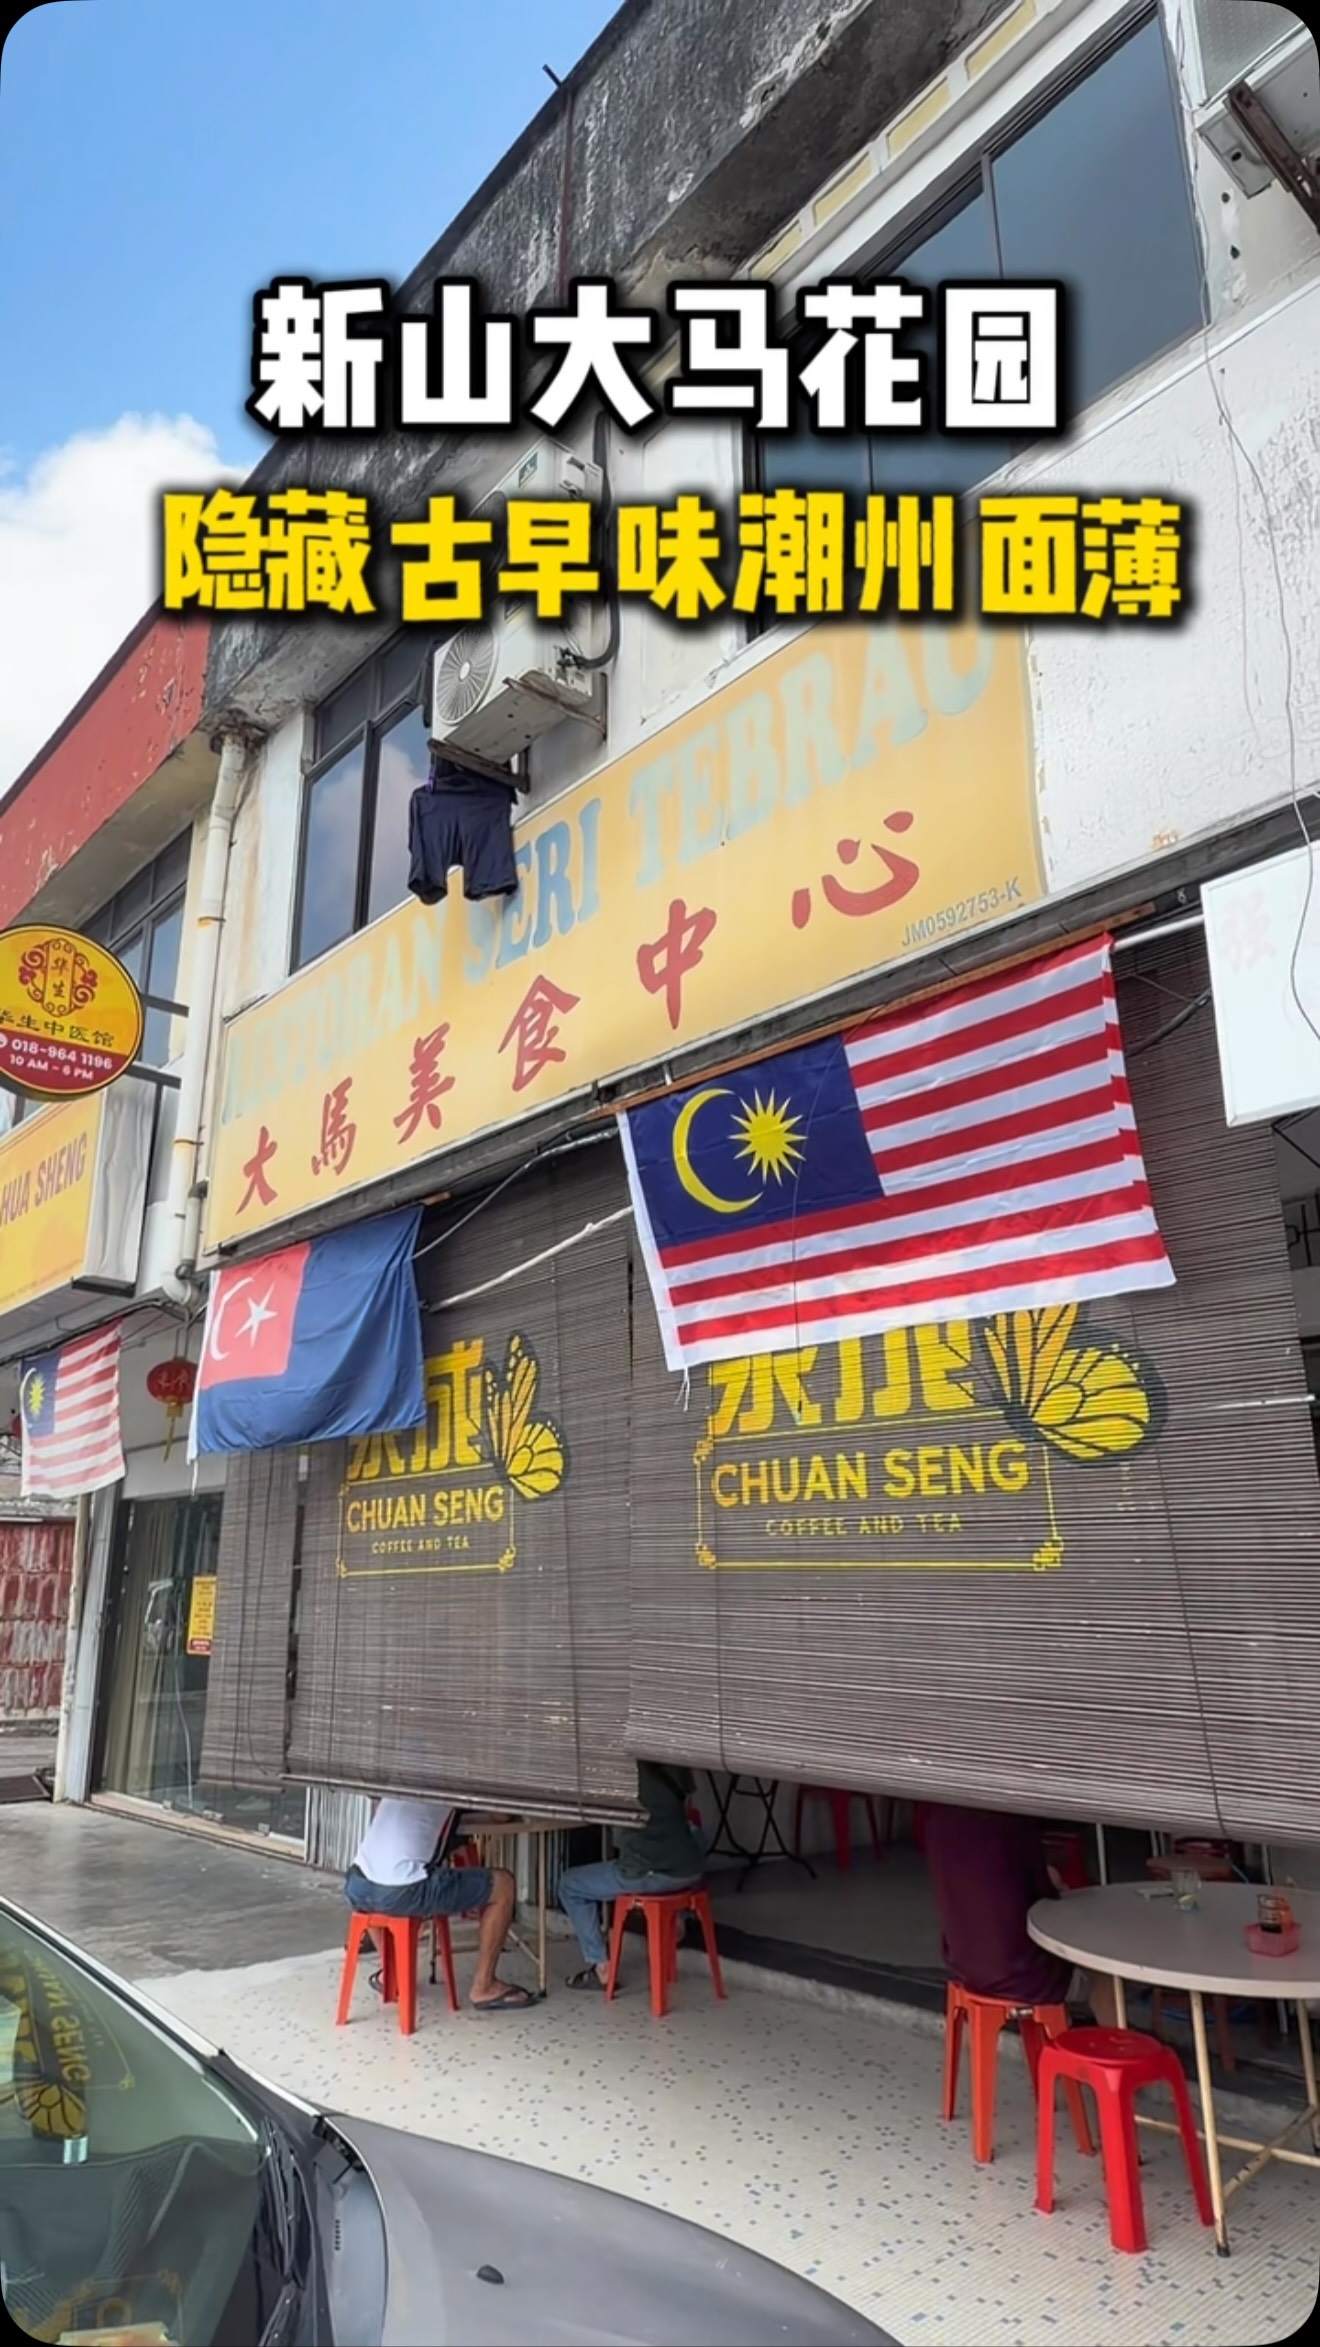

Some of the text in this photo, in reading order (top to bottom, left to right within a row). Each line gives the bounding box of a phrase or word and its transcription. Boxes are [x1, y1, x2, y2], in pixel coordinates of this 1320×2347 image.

[901, 876, 1022, 947] JM0592753-K
[236, 810, 920, 1214] 大馬美食中心
[10, 1054, 24, 1066] 10
[27, 1059, 49, 1072] AM
[62, 1065, 71, 1076] 6
[74, 1067, 94, 1080] PM
[11, 1038, 113, 1070] 018-964 1196
[35, 1132, 88, 1208] SHENG
[711, 1440, 1030, 1508] CHUAN SENG
[346, 1485, 504, 1533] CHUAN SENG
[765, 1513, 963, 1537] COFFEE AND TEA
[371, 1536, 470, 1555] COFFEE AND TEA
